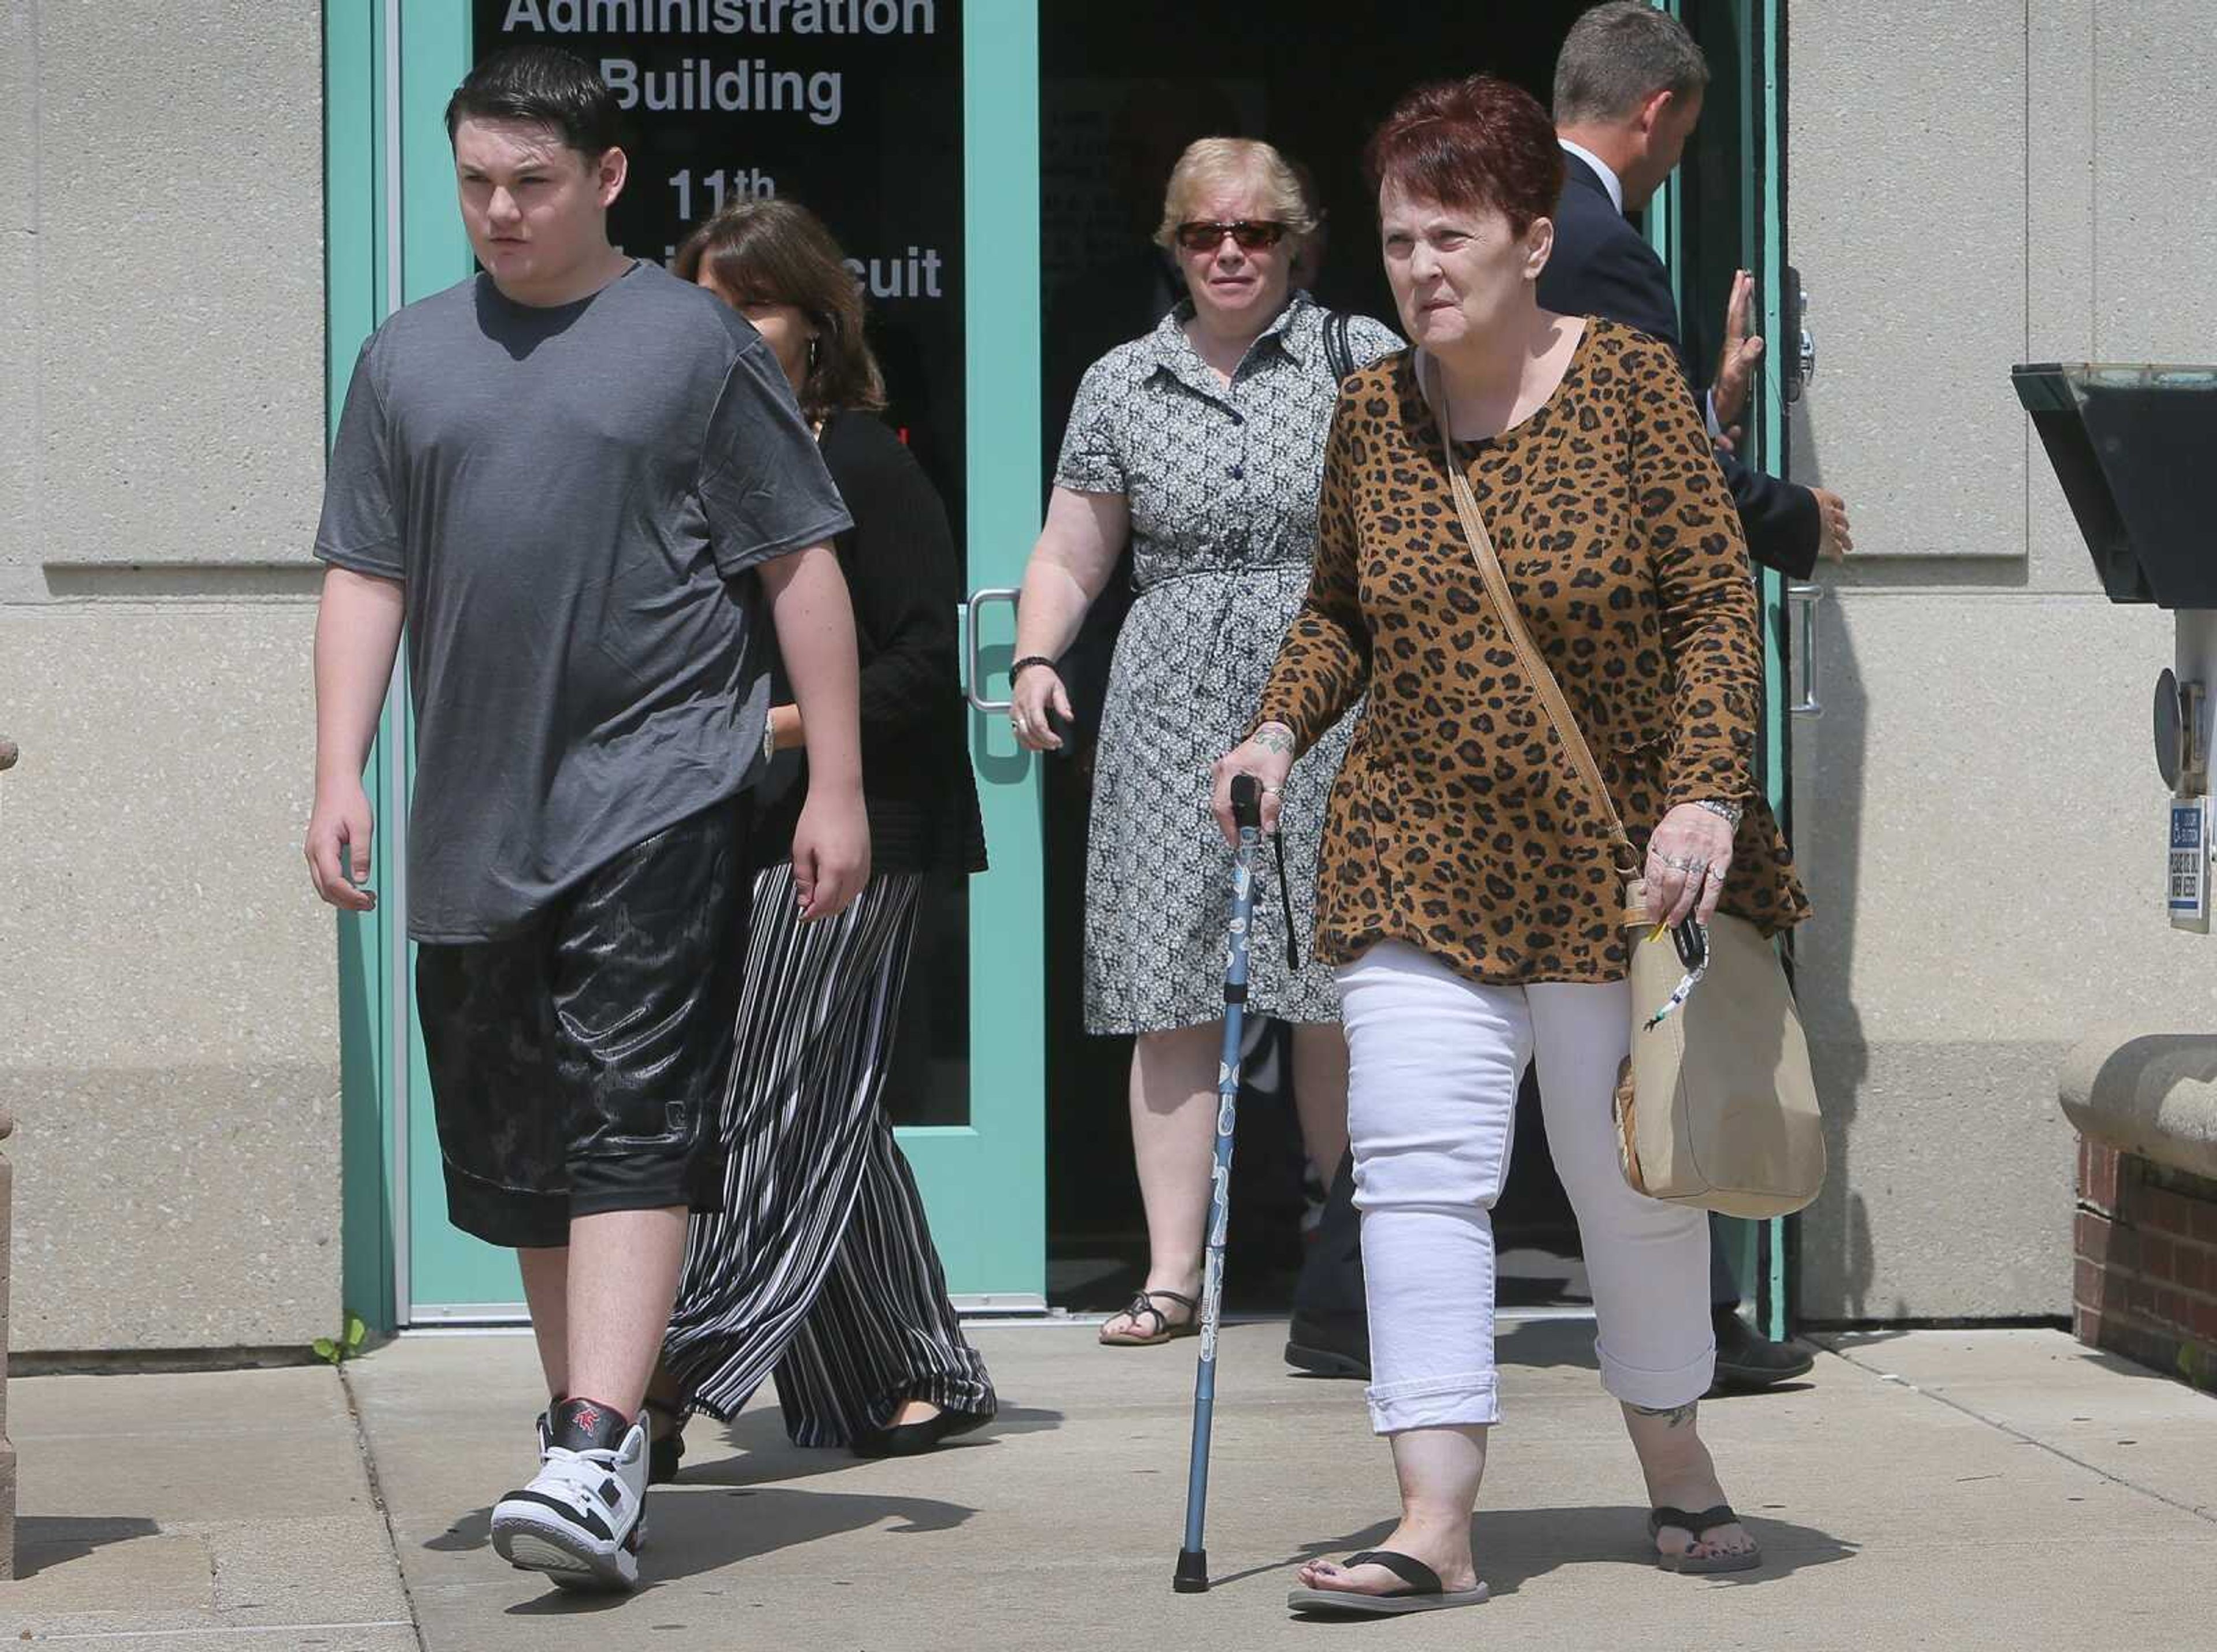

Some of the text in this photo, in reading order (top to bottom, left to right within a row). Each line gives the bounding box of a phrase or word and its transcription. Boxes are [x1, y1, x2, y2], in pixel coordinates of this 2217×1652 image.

[501, 0, 934, 34] Administration
[600, 58, 842, 125] Building
[669, 167, 775, 219] 11th
